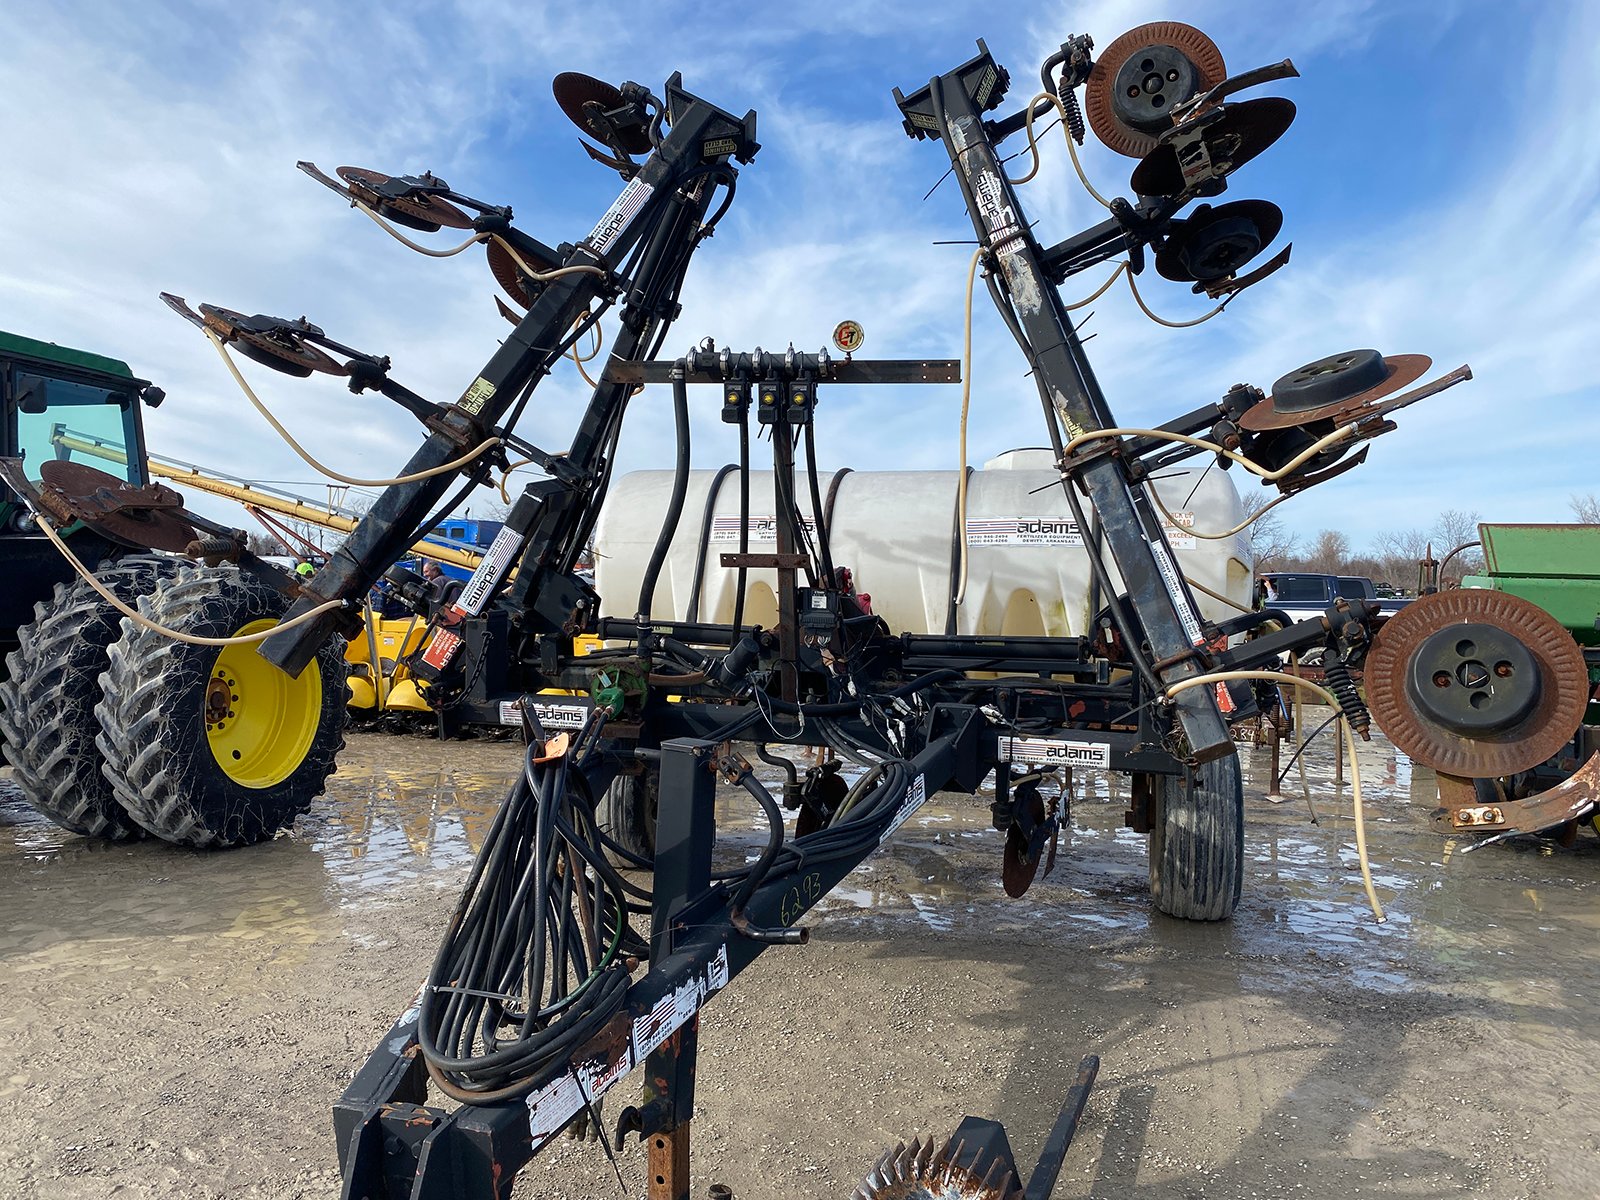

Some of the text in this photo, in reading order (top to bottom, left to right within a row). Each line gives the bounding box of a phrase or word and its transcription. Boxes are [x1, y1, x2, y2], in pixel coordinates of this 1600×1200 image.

[1017, 519, 1080, 534] adams
[467, 564, 498, 608] adams
[439, 637, 460, 667] NGER
[537, 708, 582, 721] adams
[1047, 744, 1103, 760] adams
